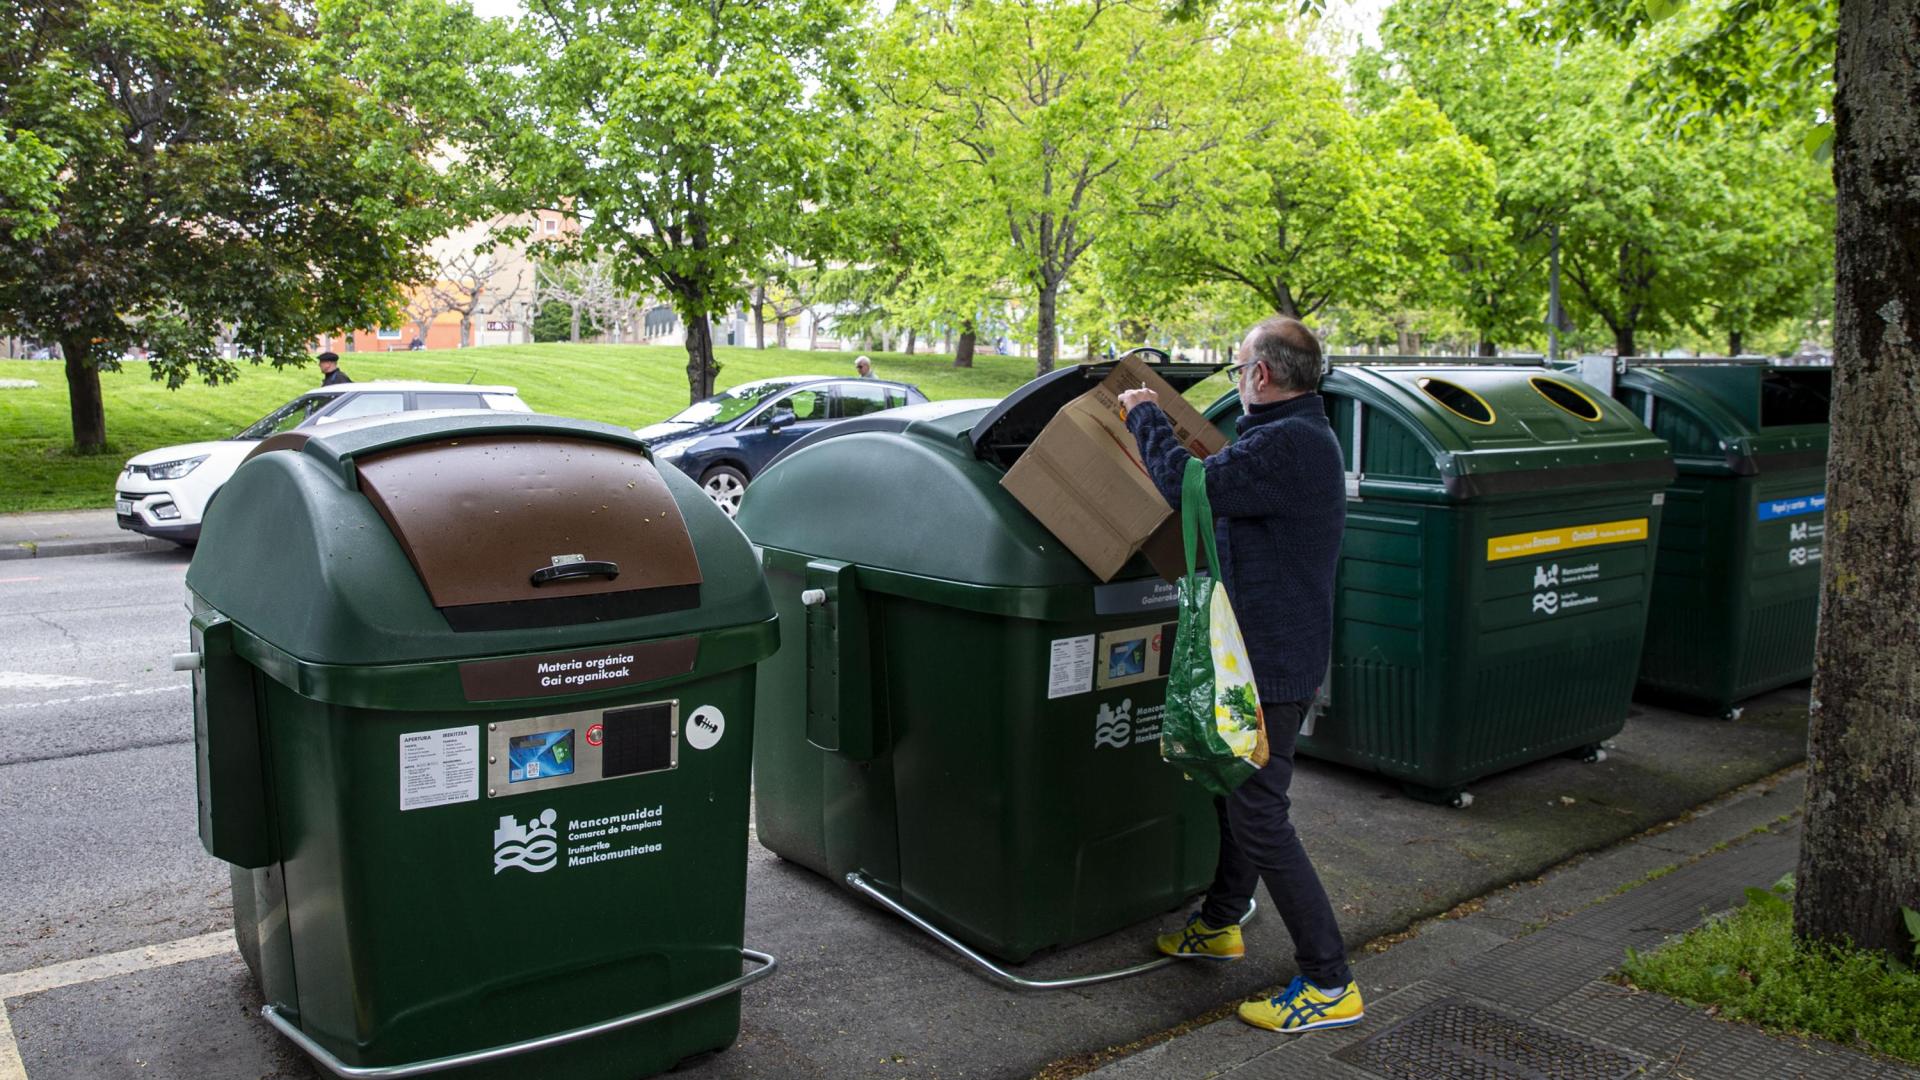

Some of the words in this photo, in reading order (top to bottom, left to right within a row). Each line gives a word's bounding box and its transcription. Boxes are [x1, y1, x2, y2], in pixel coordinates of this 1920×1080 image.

[537, 659, 582, 674] Materia
[585, 653, 634, 669] orgánica
[541, 674, 562, 687] Gai
[564, 666, 630, 685] organikoak
[404, 735, 432, 743] APERTURA
[568, 805, 663, 831] Mancomunidad
[568, 829, 606, 841] Comarca
[607, 825, 619, 835] de
[620, 819, 663, 832] Pamplona
[568, 841, 611, 855] Iruñerriko
[568, 843, 663, 867] Mankomunitatea
